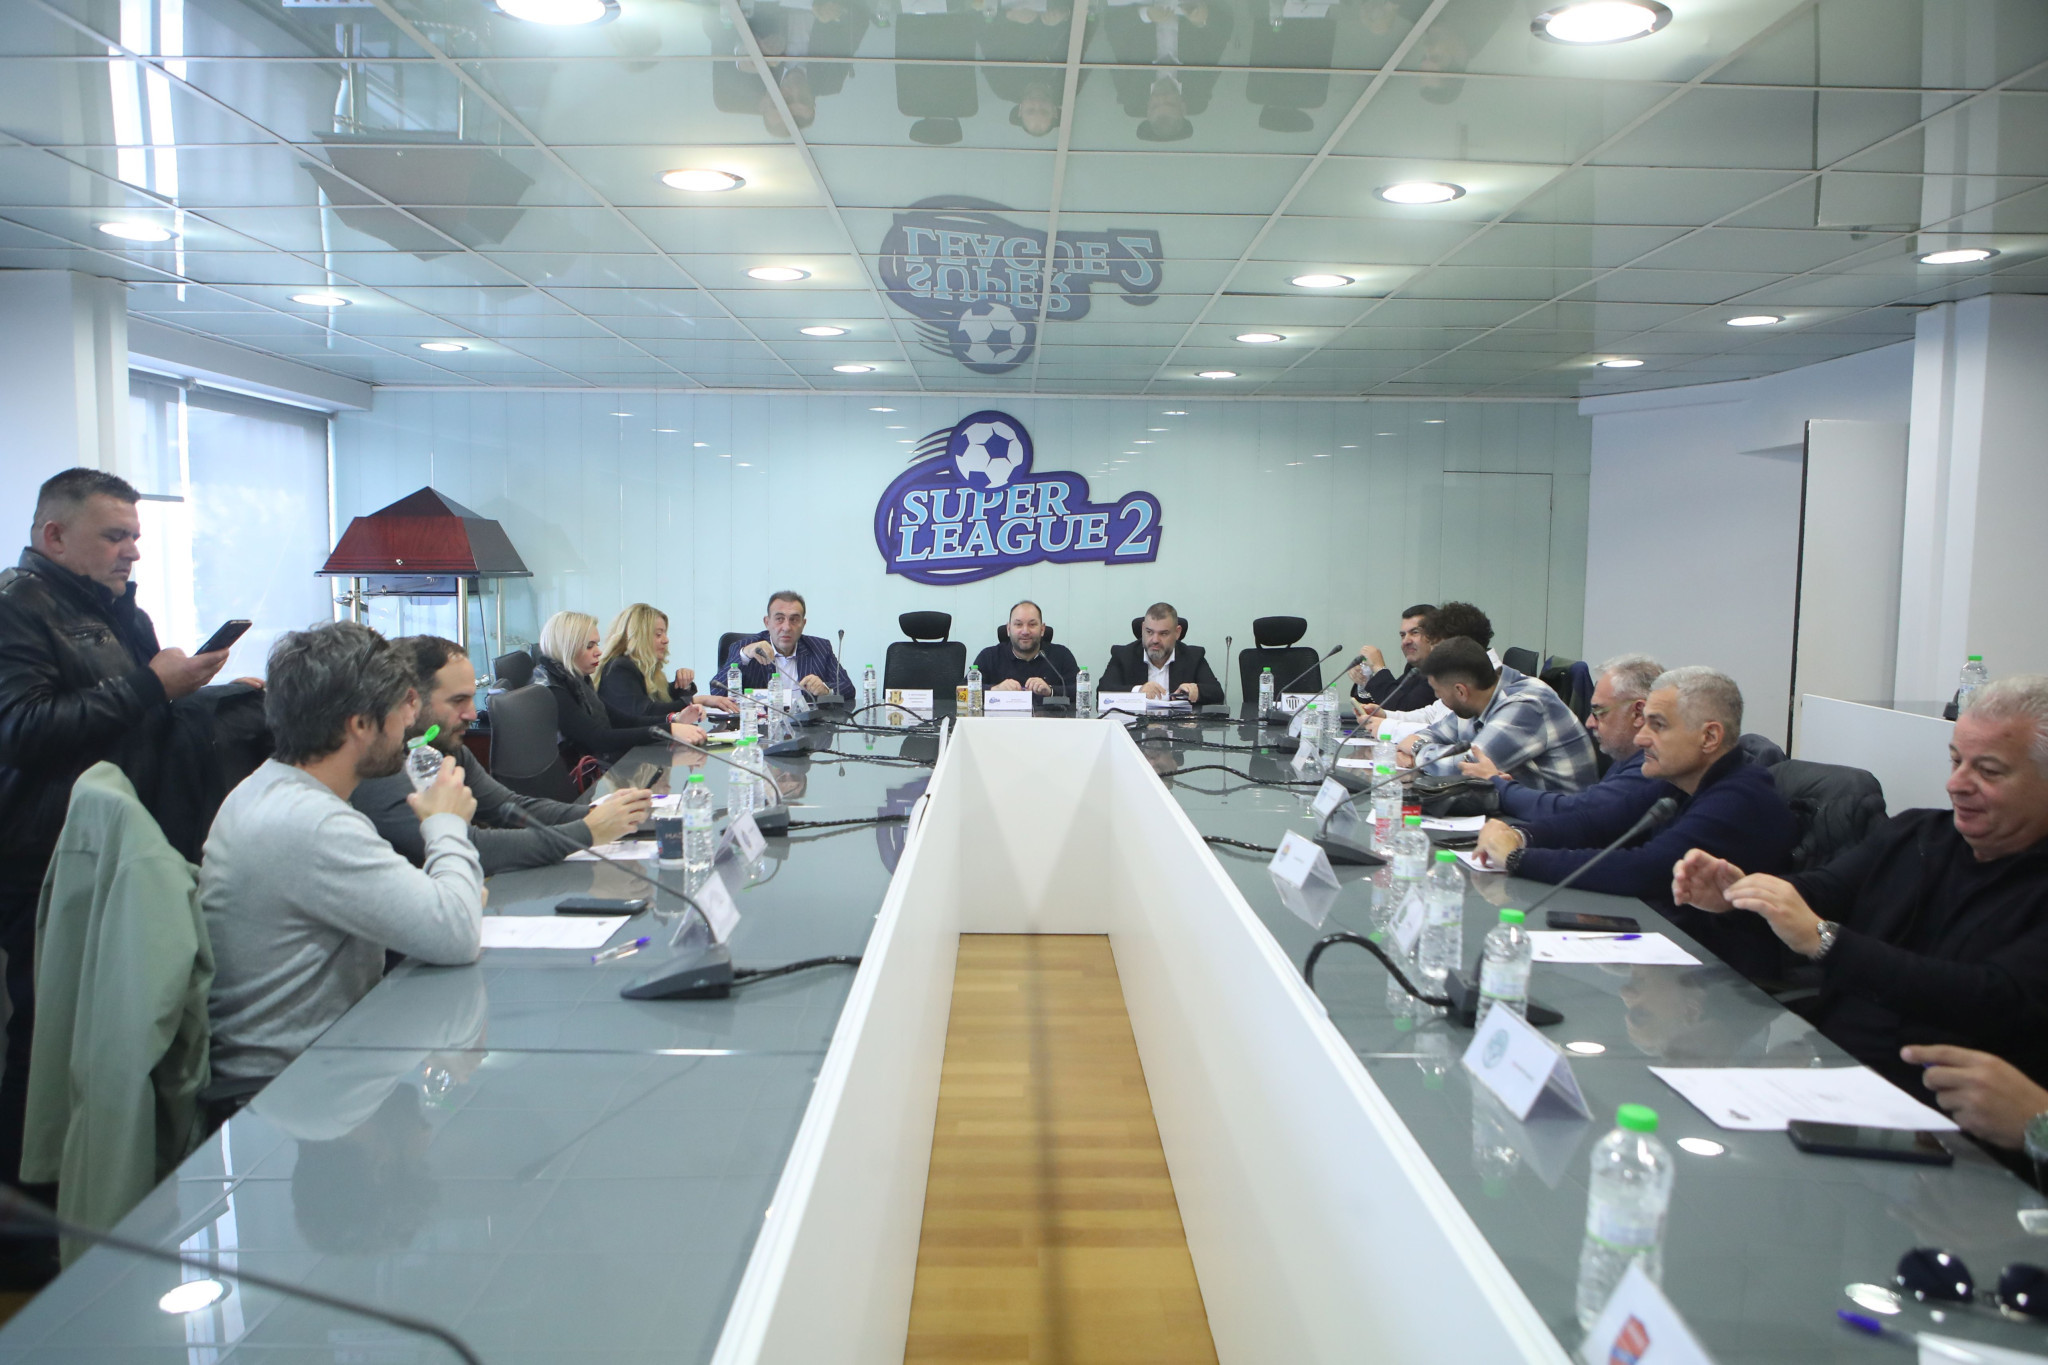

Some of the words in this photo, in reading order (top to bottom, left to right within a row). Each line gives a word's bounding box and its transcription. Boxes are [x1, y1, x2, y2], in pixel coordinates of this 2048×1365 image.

[896, 512, 1109, 562] LEAGUE
[1115, 499, 1153, 556] 2
[901, 481, 1071, 527] SUPER
